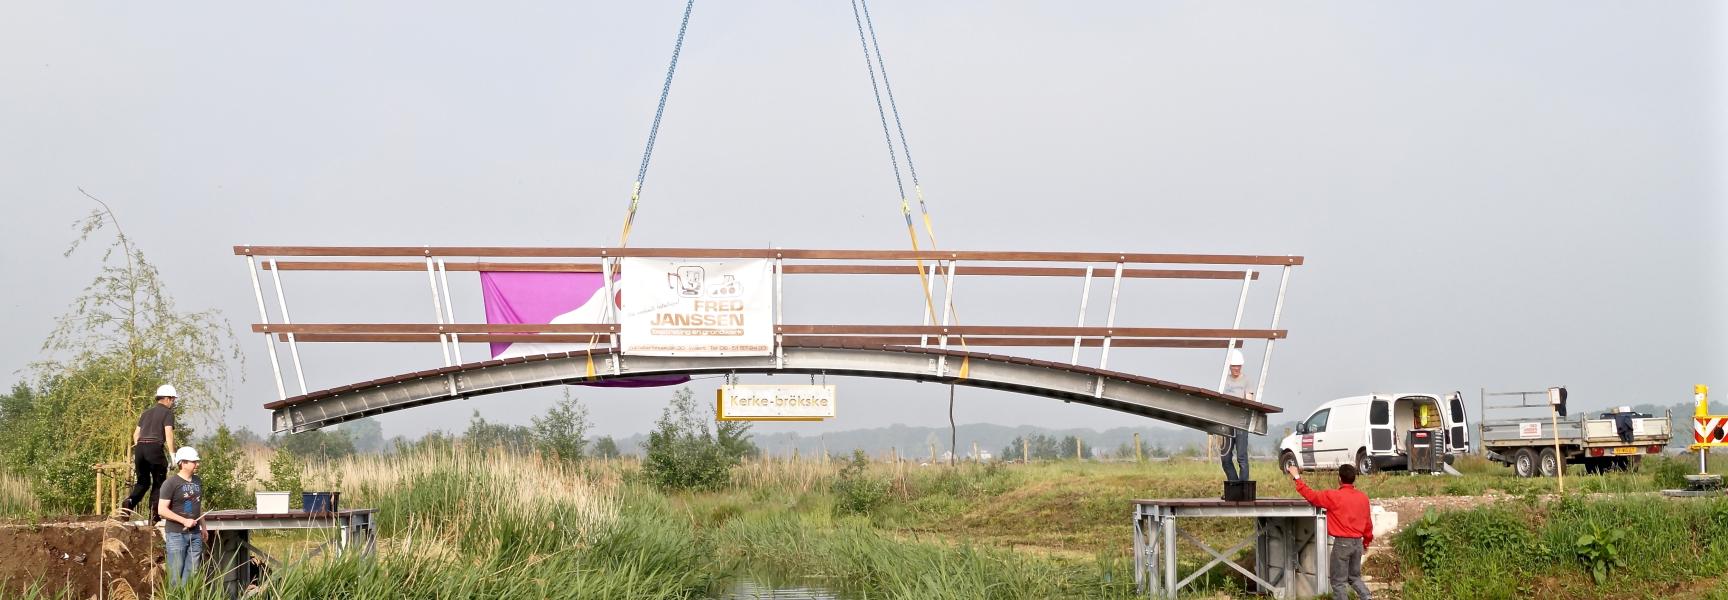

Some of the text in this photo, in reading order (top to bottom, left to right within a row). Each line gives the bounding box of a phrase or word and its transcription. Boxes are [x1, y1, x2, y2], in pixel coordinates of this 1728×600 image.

[694, 299, 743, 312] FRED
[650, 313, 744, 326] JANSSEN
[730, 395, 828, 407] Kerke-brökske
